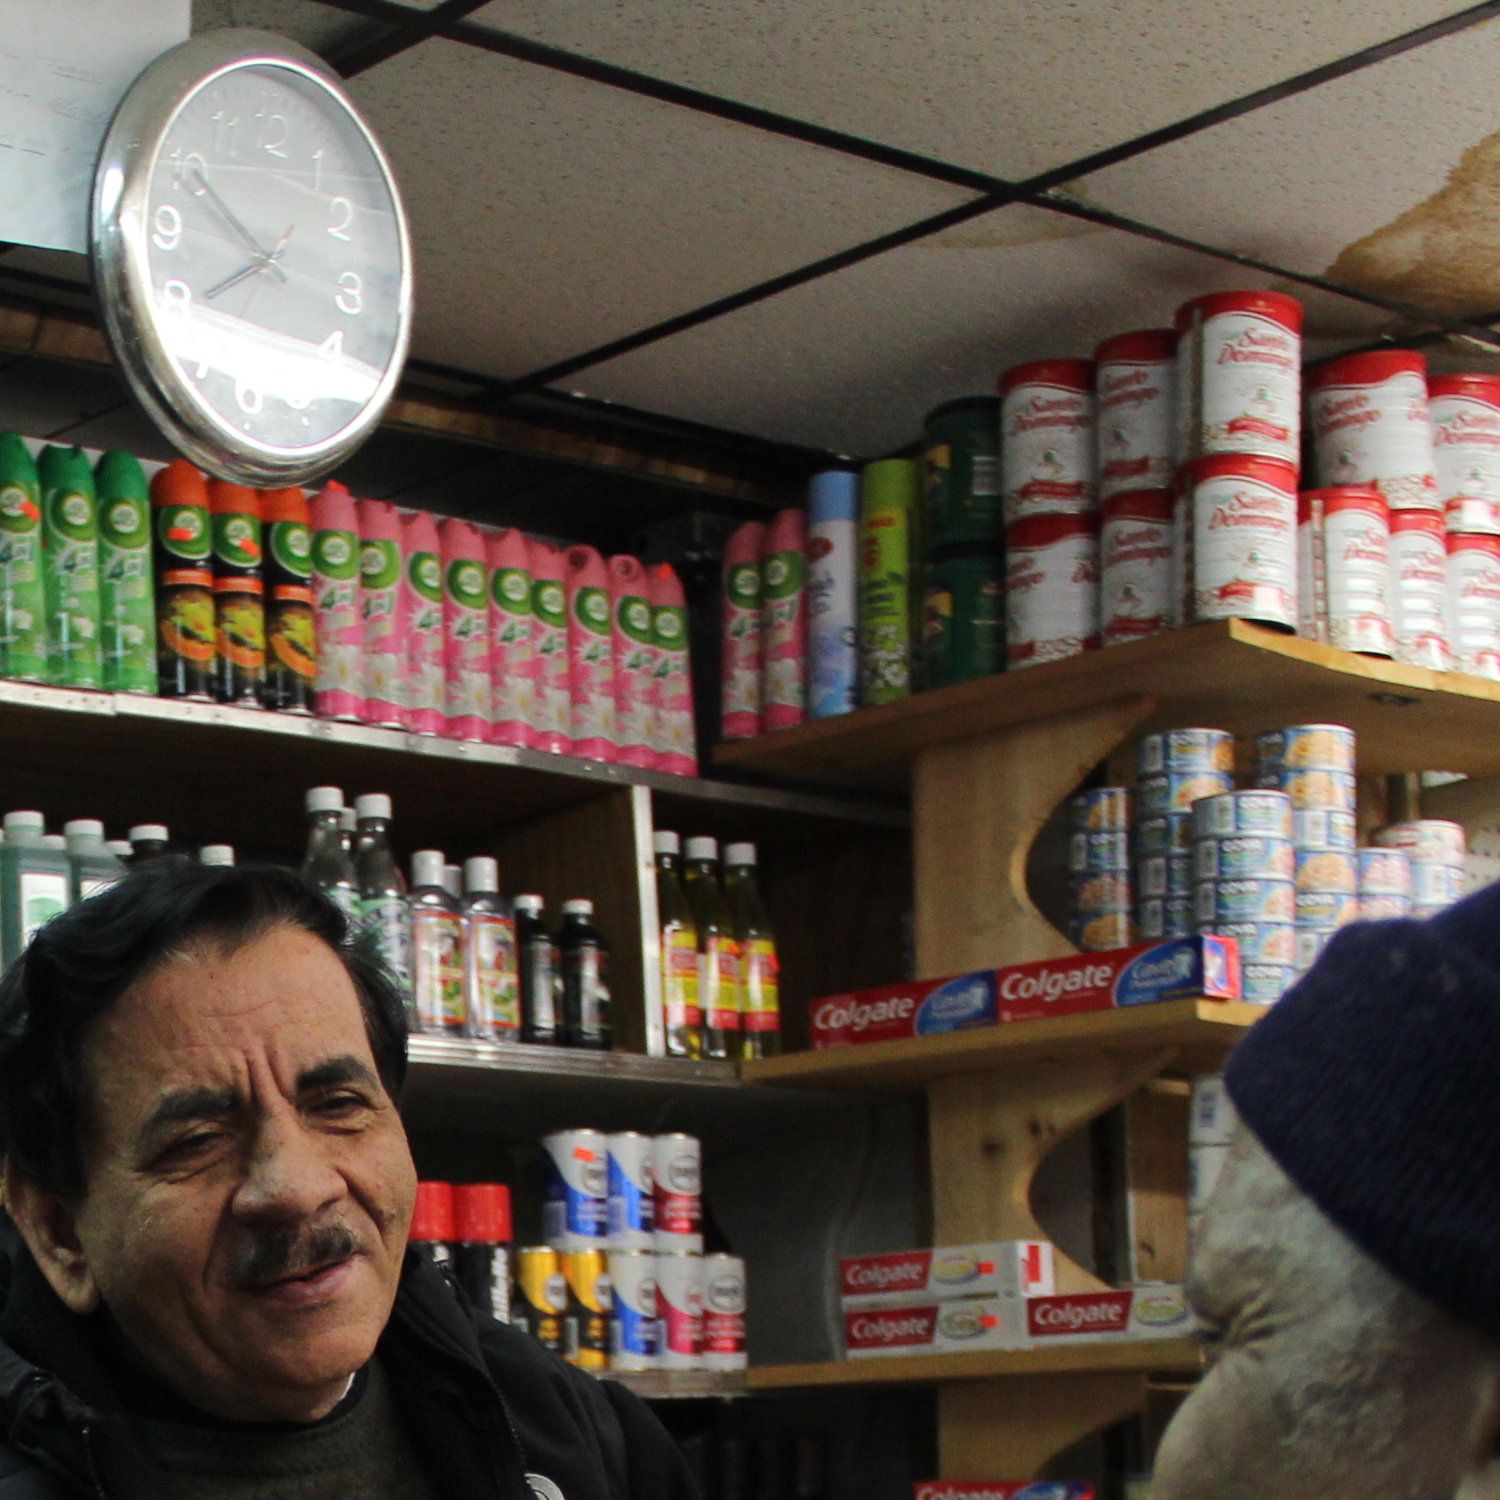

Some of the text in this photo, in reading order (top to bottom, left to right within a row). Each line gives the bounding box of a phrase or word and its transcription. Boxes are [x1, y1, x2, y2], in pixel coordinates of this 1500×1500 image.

[212, 110, 240, 157] 11
[255, 106, 287, 158] 12
[169, 148, 208, 196] 10
[311, 149, 324, 191] 1
[152, 205, 182, 250] 9
[327, 197, 354, 241] 2
[335, 272, 363, 314] 3
[1001, 963, 1114, 1003] Colgate
[813, 997, 915, 1032] Colgate
[845, 1261, 924, 1288] Colgate
[851, 1315, 930, 1341] Colgate
[1035, 1301, 1125, 1330] Colgate
